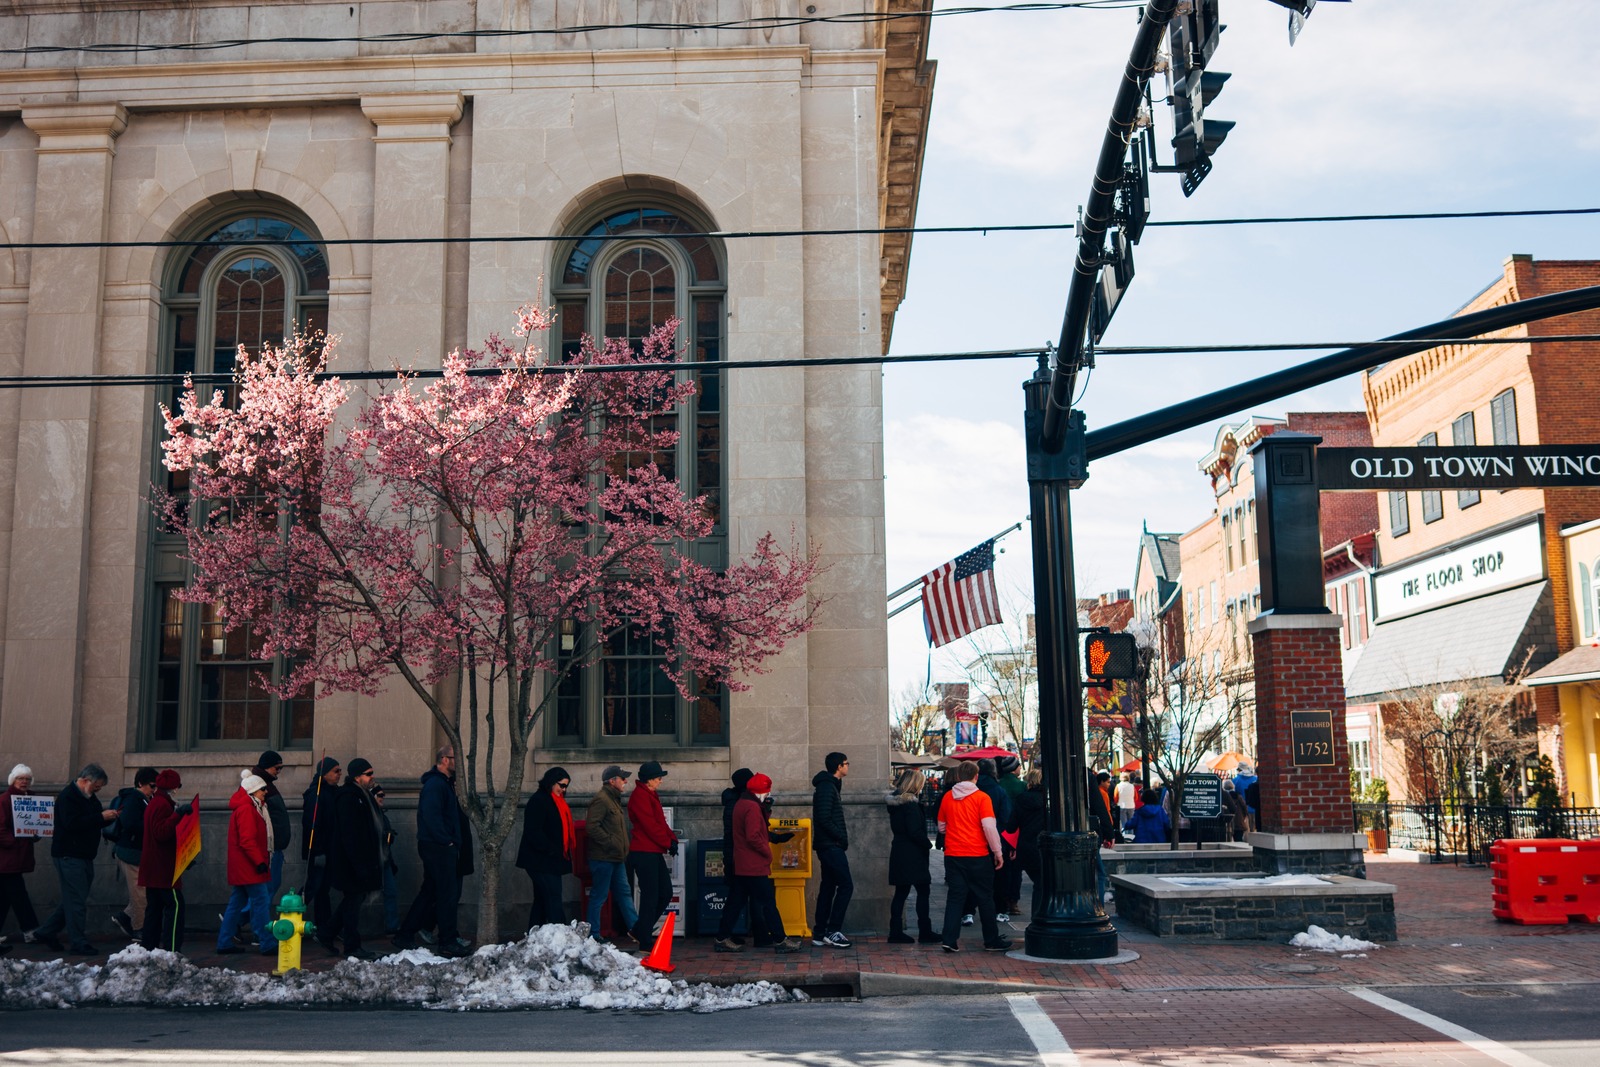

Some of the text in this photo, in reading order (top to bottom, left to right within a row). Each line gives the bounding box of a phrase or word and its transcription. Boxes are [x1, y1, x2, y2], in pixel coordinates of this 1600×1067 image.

[1350, 457, 1414, 478] OLD
[1424, 456, 1514, 478] TOWN
[1402, 551, 1504, 598] THE FLOOR SHOP
[1300, 742, 1329, 756] 1752
